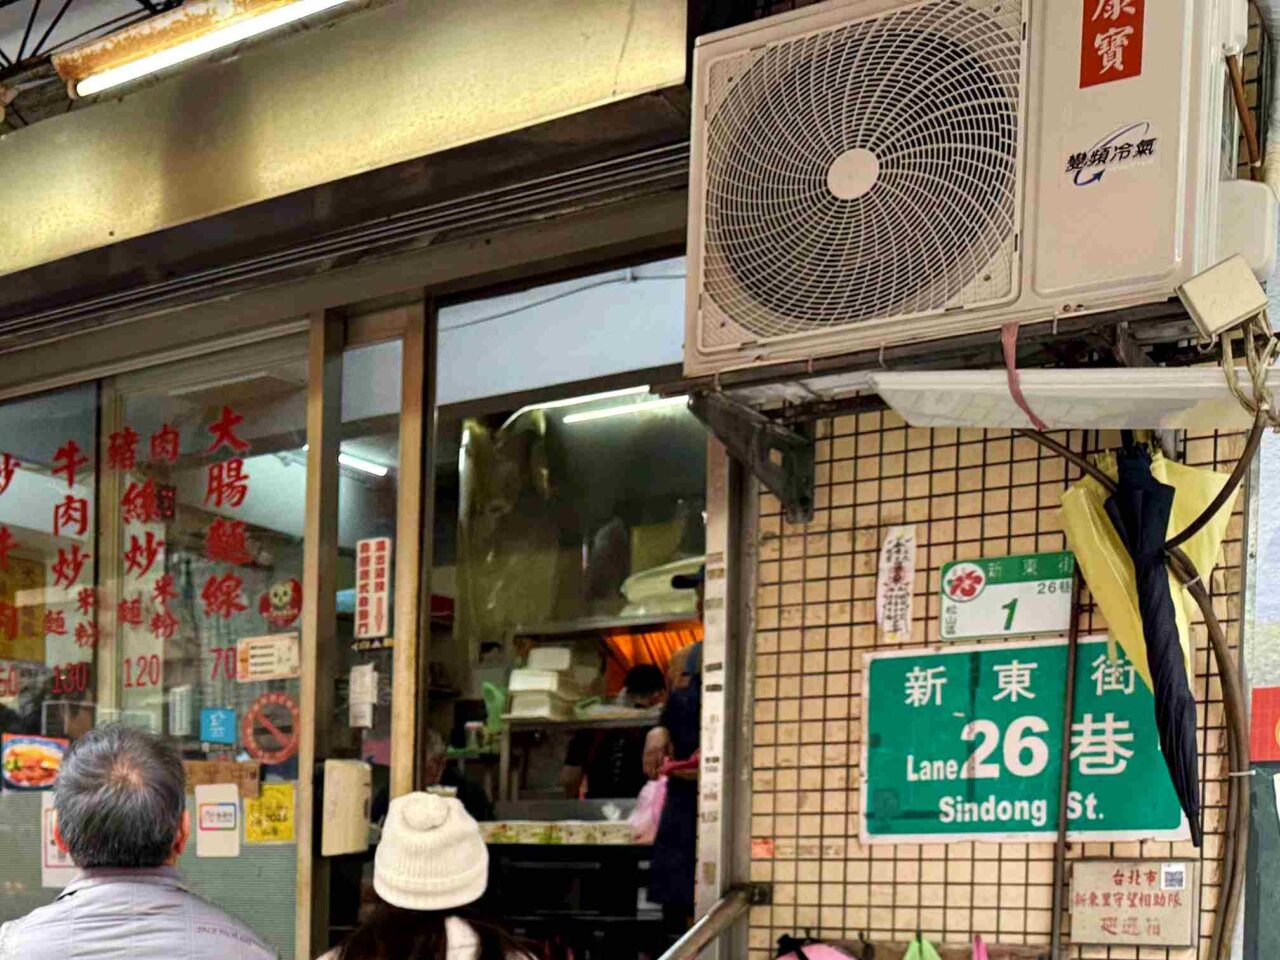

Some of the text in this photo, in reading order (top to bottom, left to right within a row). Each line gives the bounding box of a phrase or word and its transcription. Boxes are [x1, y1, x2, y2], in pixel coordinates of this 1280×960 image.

[1065, 138, 1158, 173] 變頻冷氣
[51, 440, 91, 590] 牛肉炒
[201, 405, 252, 619] 大腸麵線
[987, 556, 1075, 578] 新東街
[945, 605, 957, 635] 松山區
[1001, 598, 1019, 631] 1
[51, 662, 88, 695] 130
[124, 655, 160, 689] 120
[209, 648, 237, 680] 70
[904, 654, 1136, 707] 新東街
[906, 755, 958, 782] Lane
[938, 792, 1105, 827] Sindong St.
[1112, 869, 1158, 886] 台北市
[1073, 891, 1183, 908] 新東里守望相助隊
